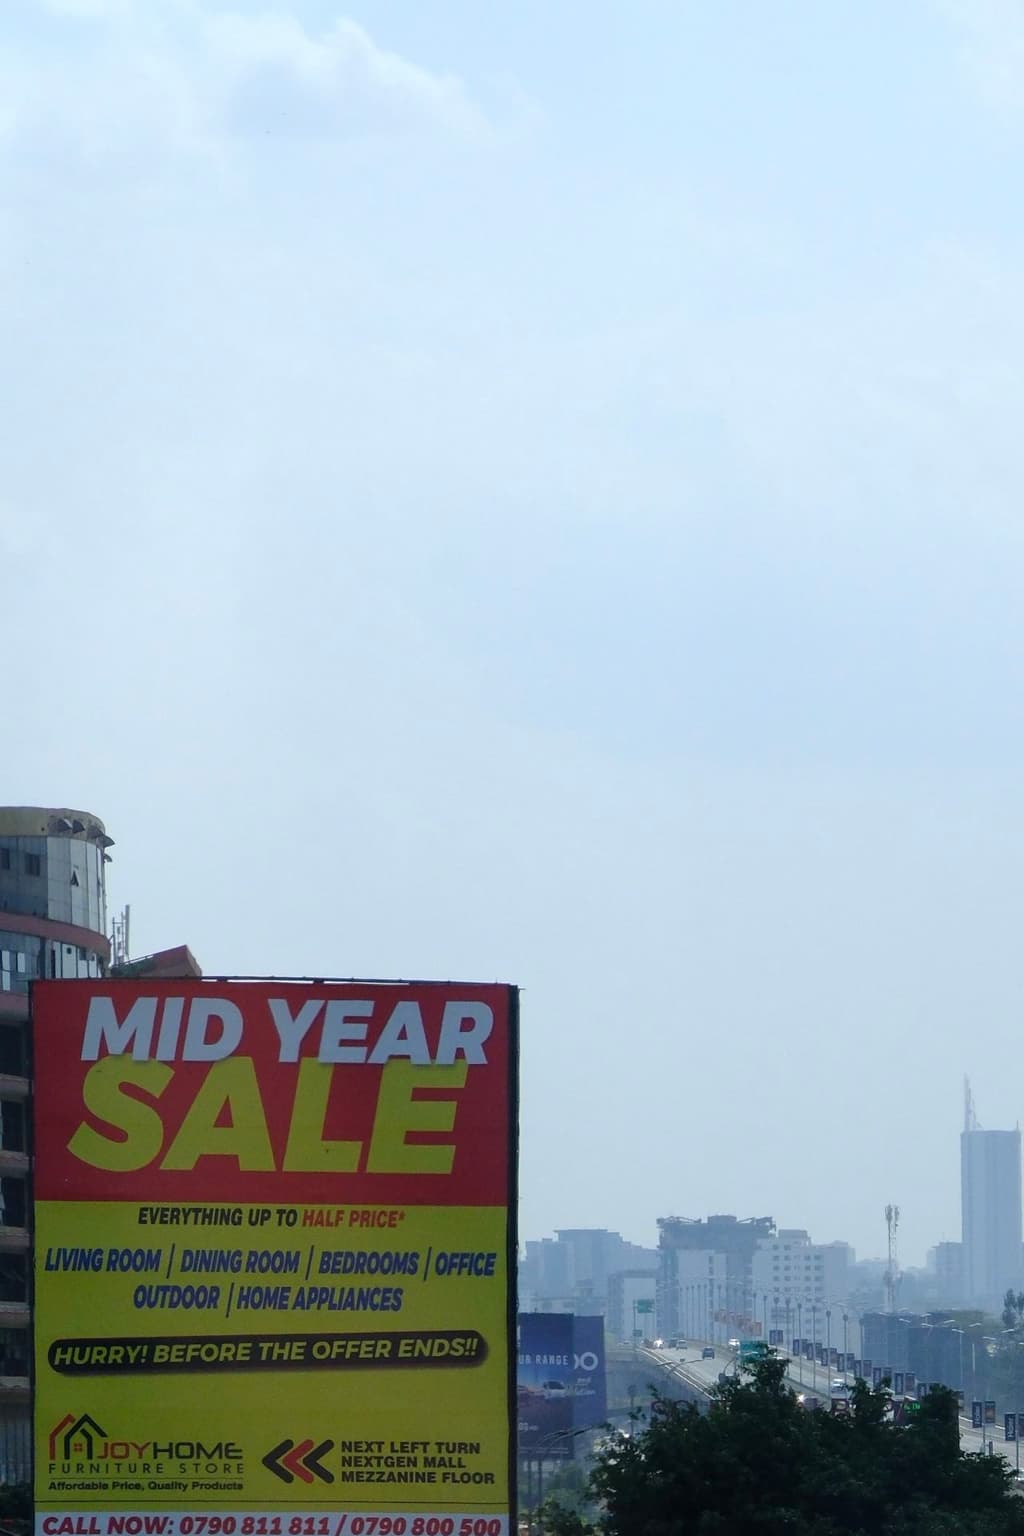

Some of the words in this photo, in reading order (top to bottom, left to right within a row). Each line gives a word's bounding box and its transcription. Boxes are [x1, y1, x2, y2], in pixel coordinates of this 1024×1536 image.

[80, 996, 245, 1062] MID
[267, 998, 494, 1065] YEAR
[66, 1053, 469, 1175] SALE
[138, 1207, 244, 1227] EVERYTHING
[248, 1209, 271, 1227] UP
[276, 1209, 298, 1228] TO
[302, 1209, 345, 1228] HALF
[44, 1248, 104, 1272] LIVING
[106, 1249, 162, 1273] ROOM
[180, 1249, 242, 1273] DINING
[245, 1250, 300, 1274] ROOM
[318, 1250, 419, 1275] BEDROOMS
[435, 1252, 497, 1277] OFFICE
[133, 1284, 220, 1310] OUTDOOR
[236, 1286, 290, 1311] HOME
[292, 1286, 404, 1312] APPLIANCES
[55, 1343, 148, 1366] HURRY!
[153, 1342, 251, 1364] BEFORE
[258, 1341, 306, 1361] THE
[311, 1339, 391, 1361] OFFER
[398, 1337, 479, 1358] ENDS!!
[535, 1354, 569, 1366] RANGE
[341, 1440, 385, 1454] NEXT
[389, 1441, 431, 1454] LEFT
[435, 1441, 481, 1455] TURN
[48, 1462, 164, 1475] FURNITURE
[178, 1461, 244, 1475] STORE
[341, 1455, 420, 1469] NEXTGEN
[423, 1456, 467, 1469] MALL
[48, 1480, 108, 1491] Affordable
[111, 1480, 145, 1492] Price,
[147, 1481, 187, 1493] Quality
[189, 1480, 244, 1491] Products
[341, 1470, 438, 1484] MEZZANINE
[442, 1471, 495, 1485] FLOOR
[42, 1516, 102, 1535] CALL
[107, 1516, 174, 1535] NOW:
[180, 1516, 236, 1535] 0790
[241, 1517, 282, 1535] 811
[288, 1517, 330, 1535] 811
[351, 1517, 406, 1536] 0790
[411, 1517, 456, 1536] 800
